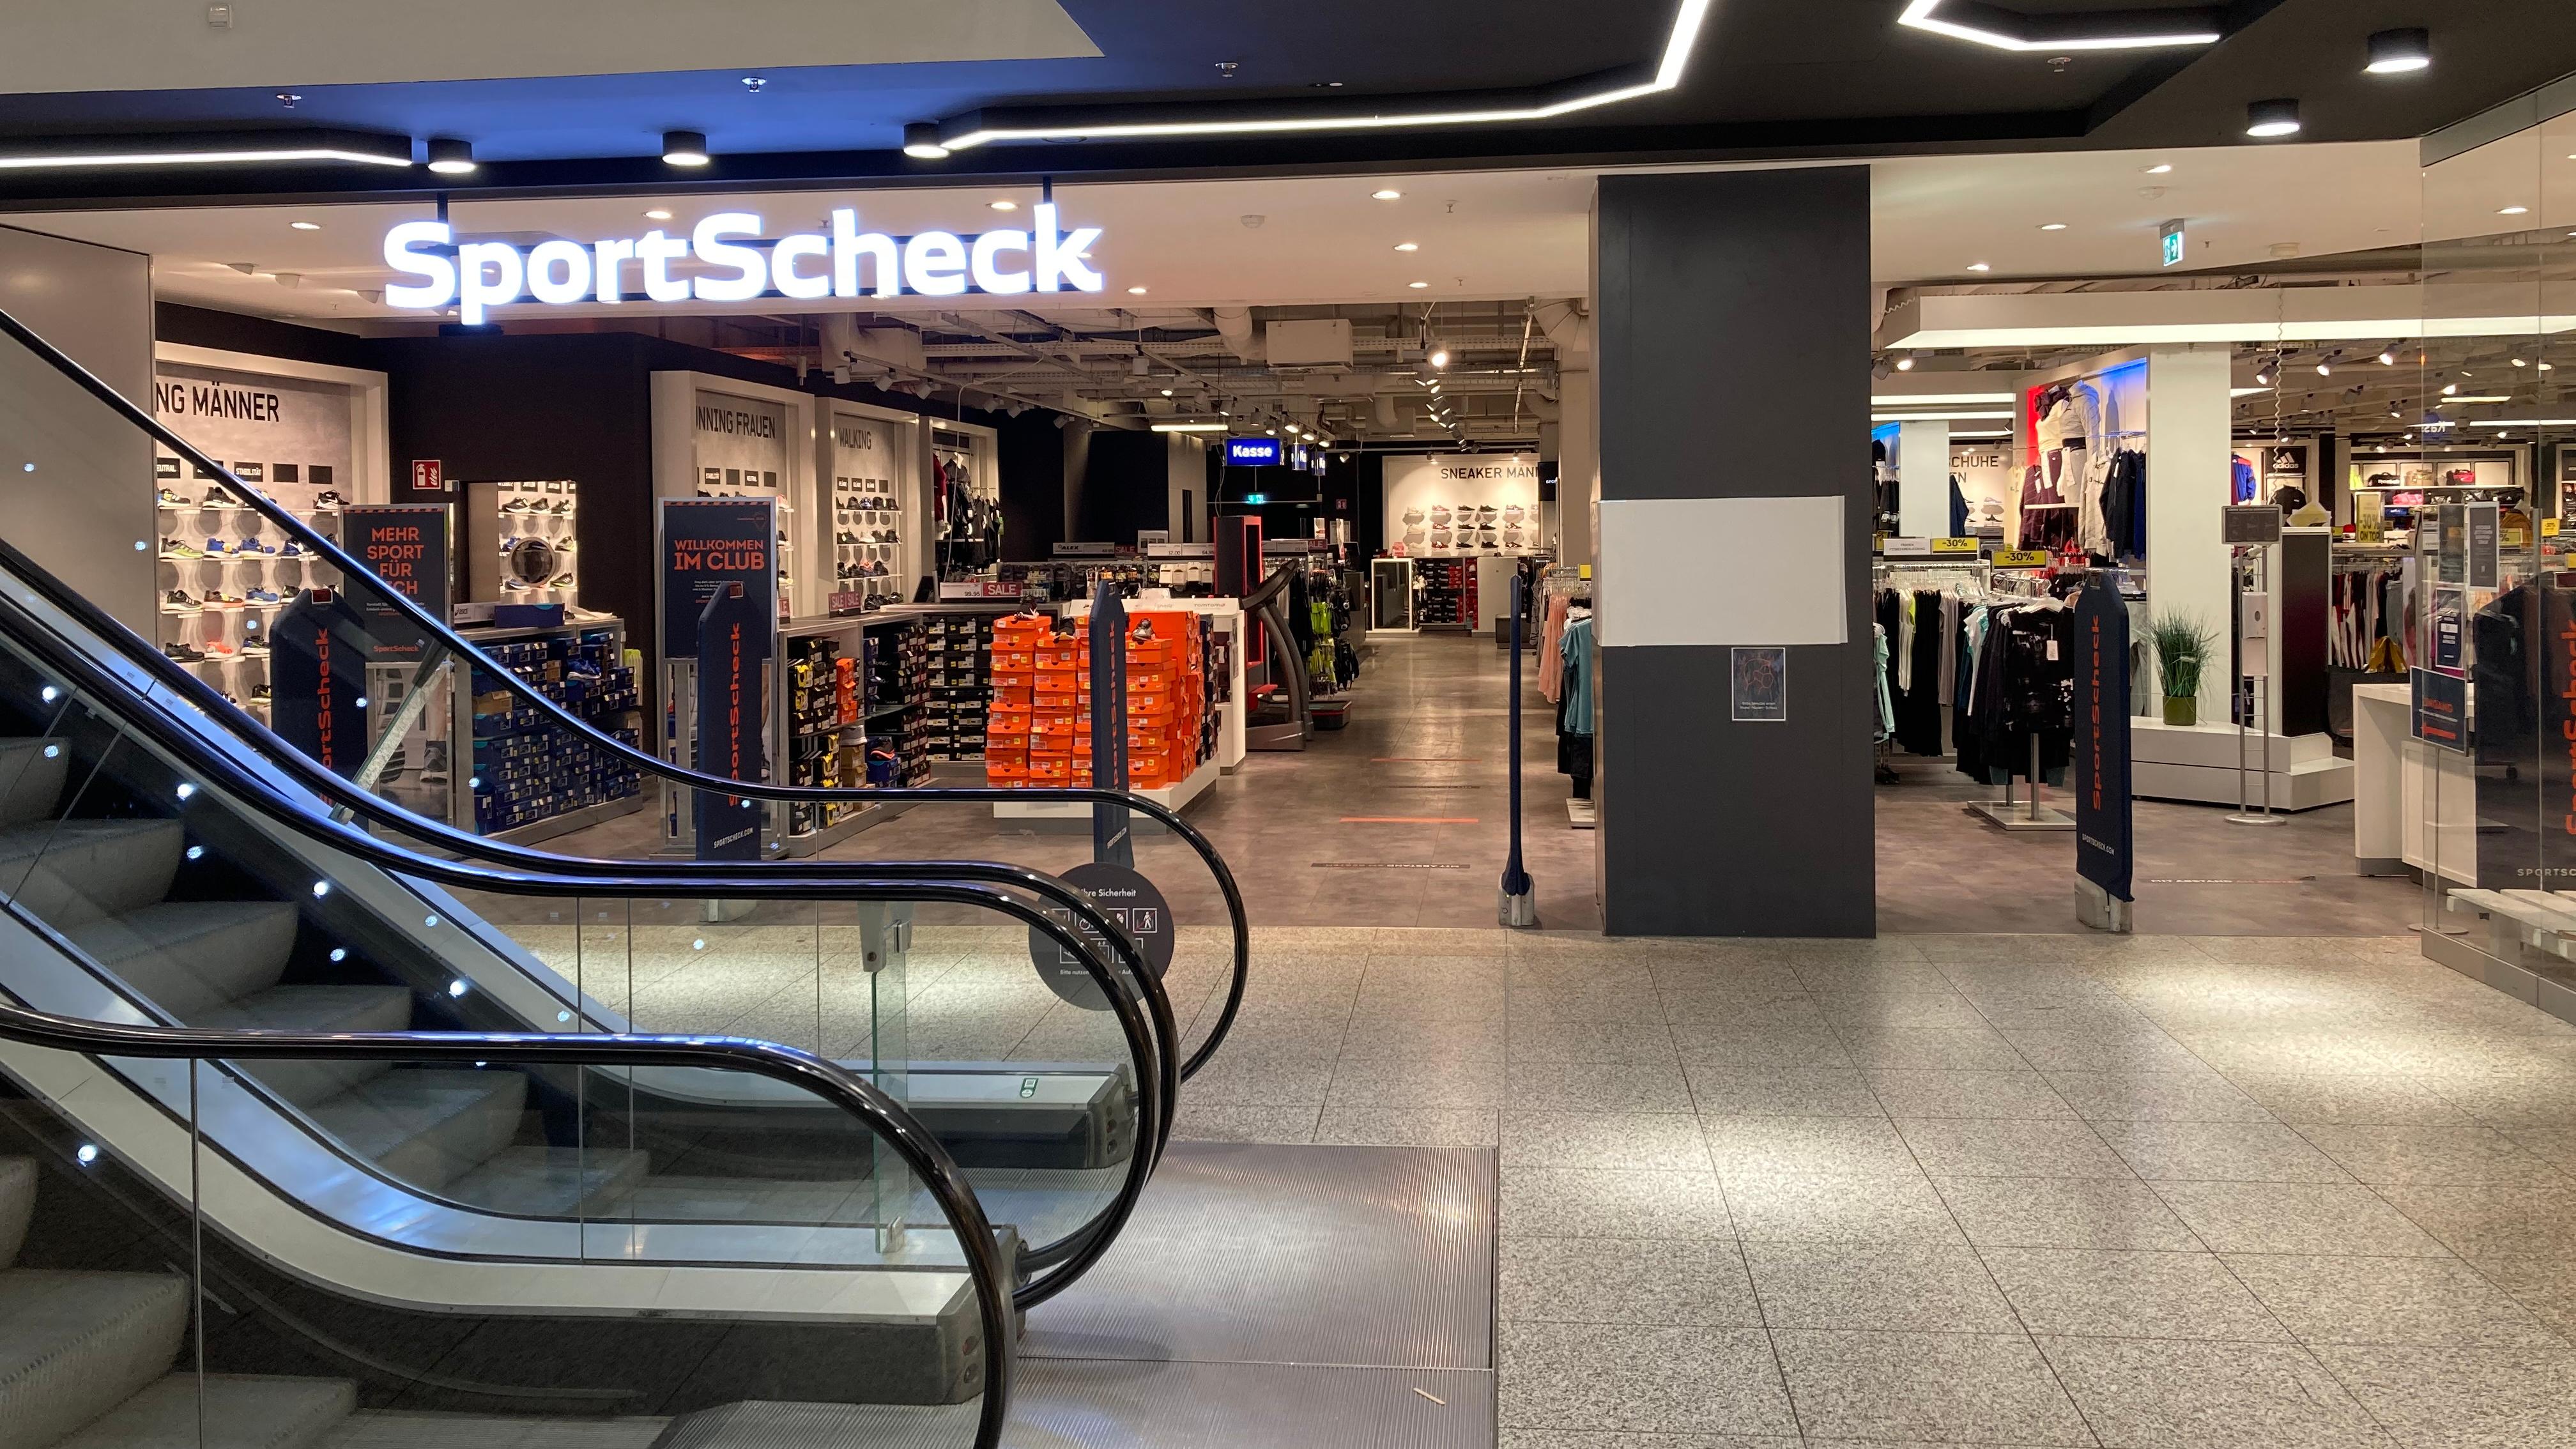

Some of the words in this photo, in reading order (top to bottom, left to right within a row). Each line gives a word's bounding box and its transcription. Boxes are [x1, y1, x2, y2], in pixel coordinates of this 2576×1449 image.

[385, 203, 1103, 326] SportScheck
[156, 382, 185, 414] NG
[192, 381, 279, 422] MÄNNER
[696, 406, 733, 434] NNING
[736, 411, 776, 439] FRAUEN
[839, 427, 871, 450] WALKING
[1232, 445, 1273, 457] Kasse
[157, 464, 176, 472] EUTRAL
[1949, 456, 1999, 467] CHUHE
[1441, 467, 1501, 479] SNEAKER
[1506, 464, 1538, 478] MÄN
[371, 527, 420, 542] MEHR
[674, 539, 763, 551] WILLKOMMEN
[1942, 539, 1968, 547] -30%
[367, 544, 424, 560] SPORT
[2005, 552, 2035, 561] -30%
[674, 552, 701, 571] IM
[707, 551, 765, 571] CLUB
[379, 562, 413, 576] FÜR
[988, 584, 1016, 595] SALE
[831, 595, 844, 609] SALE
[847, 593, 859, 606] SALE
[1109, 620, 1119, 788] portScheck
[2091, 615, 2101, 811] SportScheck
[2517, 868, 2576, 877] SPORTSC
[1098, 888, 1137, 897] Sicherheit
